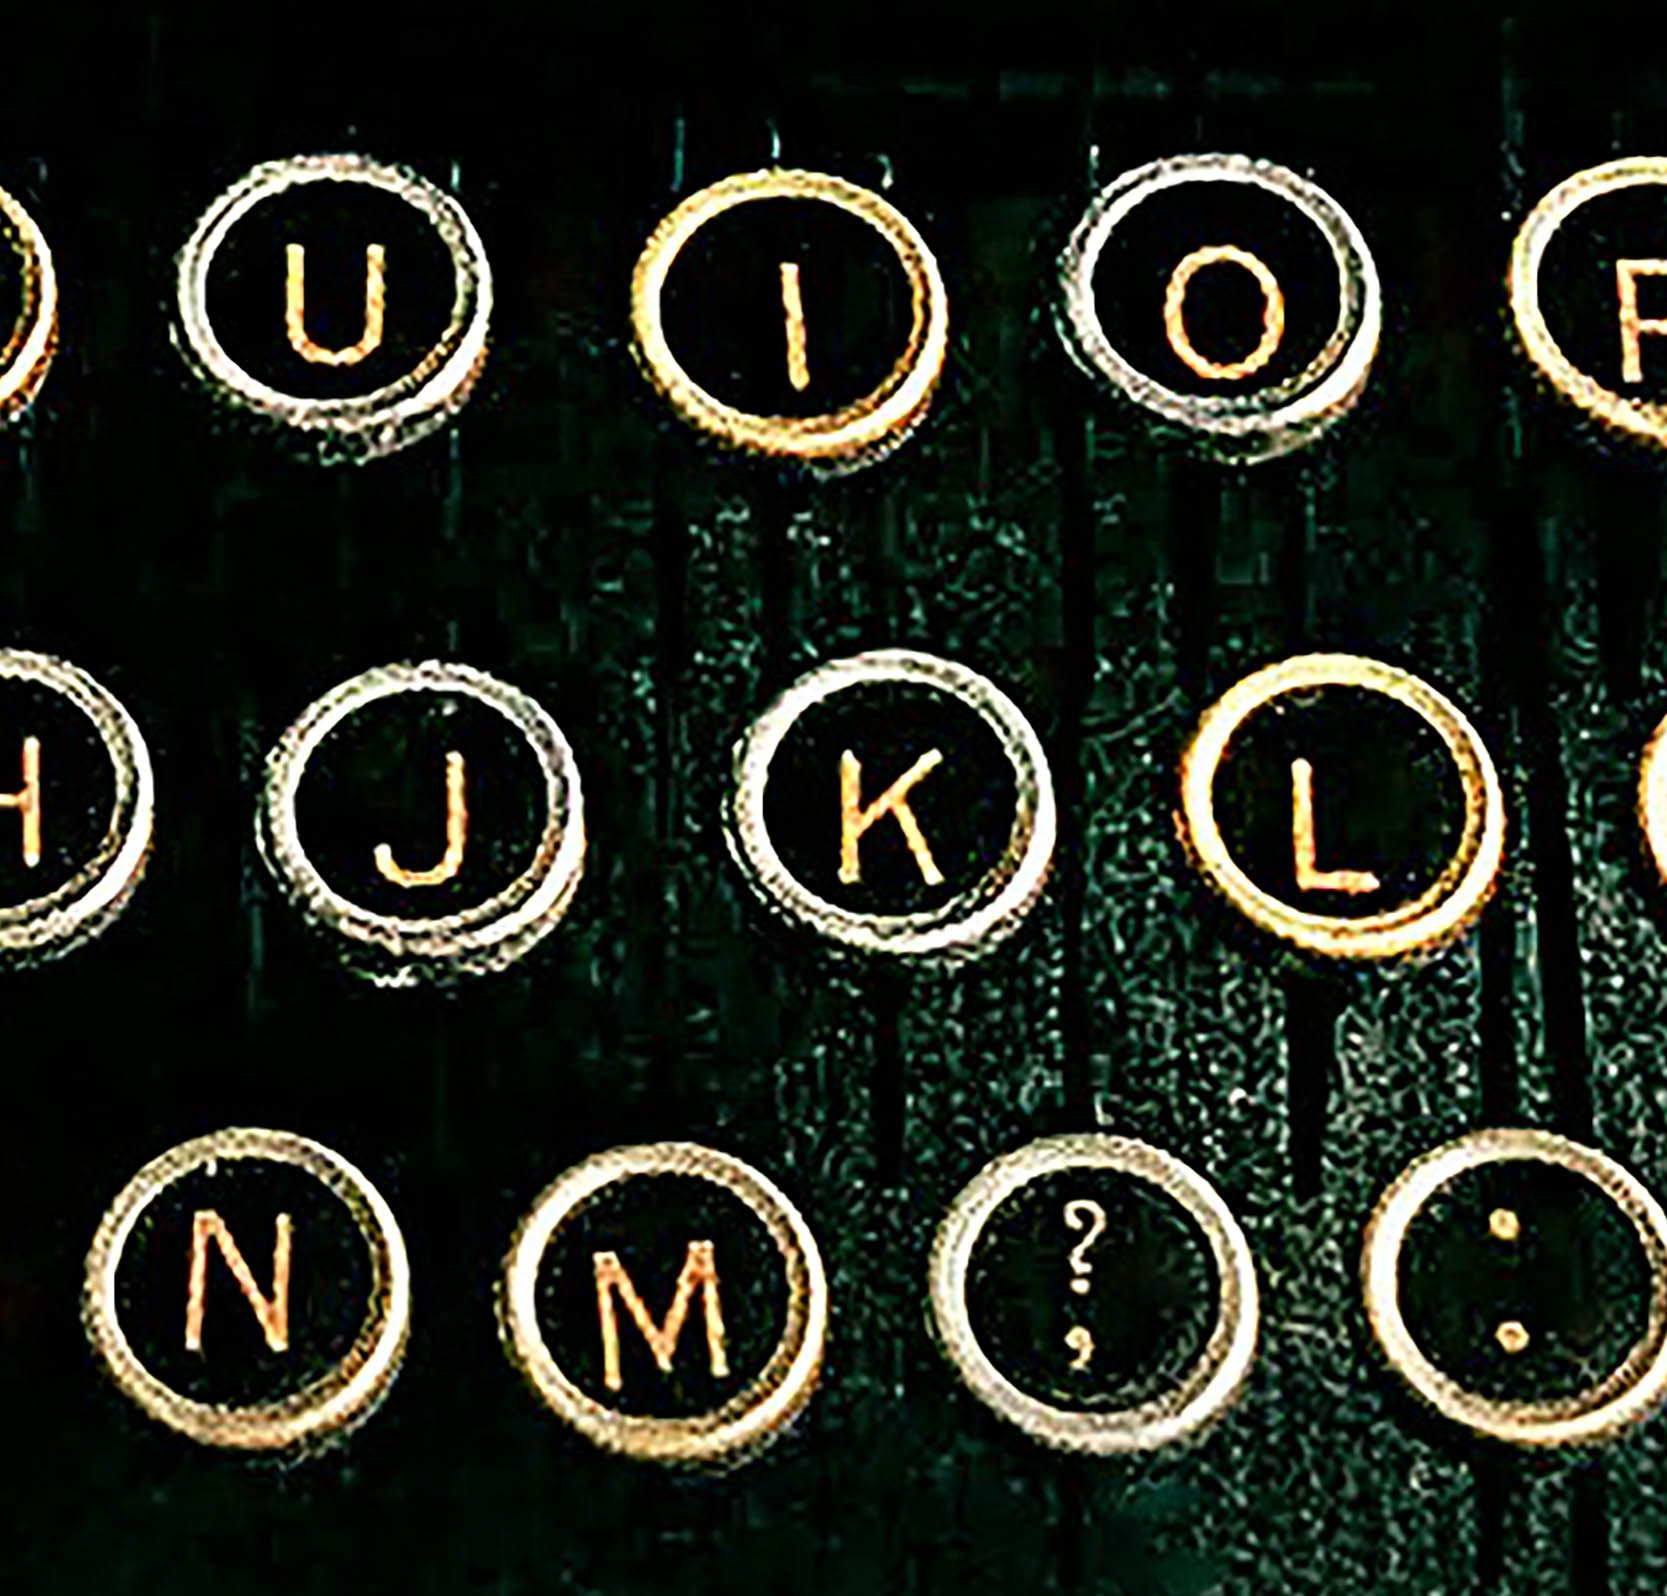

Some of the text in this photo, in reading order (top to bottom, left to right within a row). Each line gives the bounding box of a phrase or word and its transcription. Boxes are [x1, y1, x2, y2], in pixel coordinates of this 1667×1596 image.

[285, 244, 385, 366] U
[780, 262, 810, 390] I
[1164, 245, 1284, 380] O
[374, 751, 468, 888] J
[838, 749, 944, 885] K
[1291, 758, 1380, 895] L
[186, 1210, 293, 1352] N
[593, 1240, 729, 1391] M
